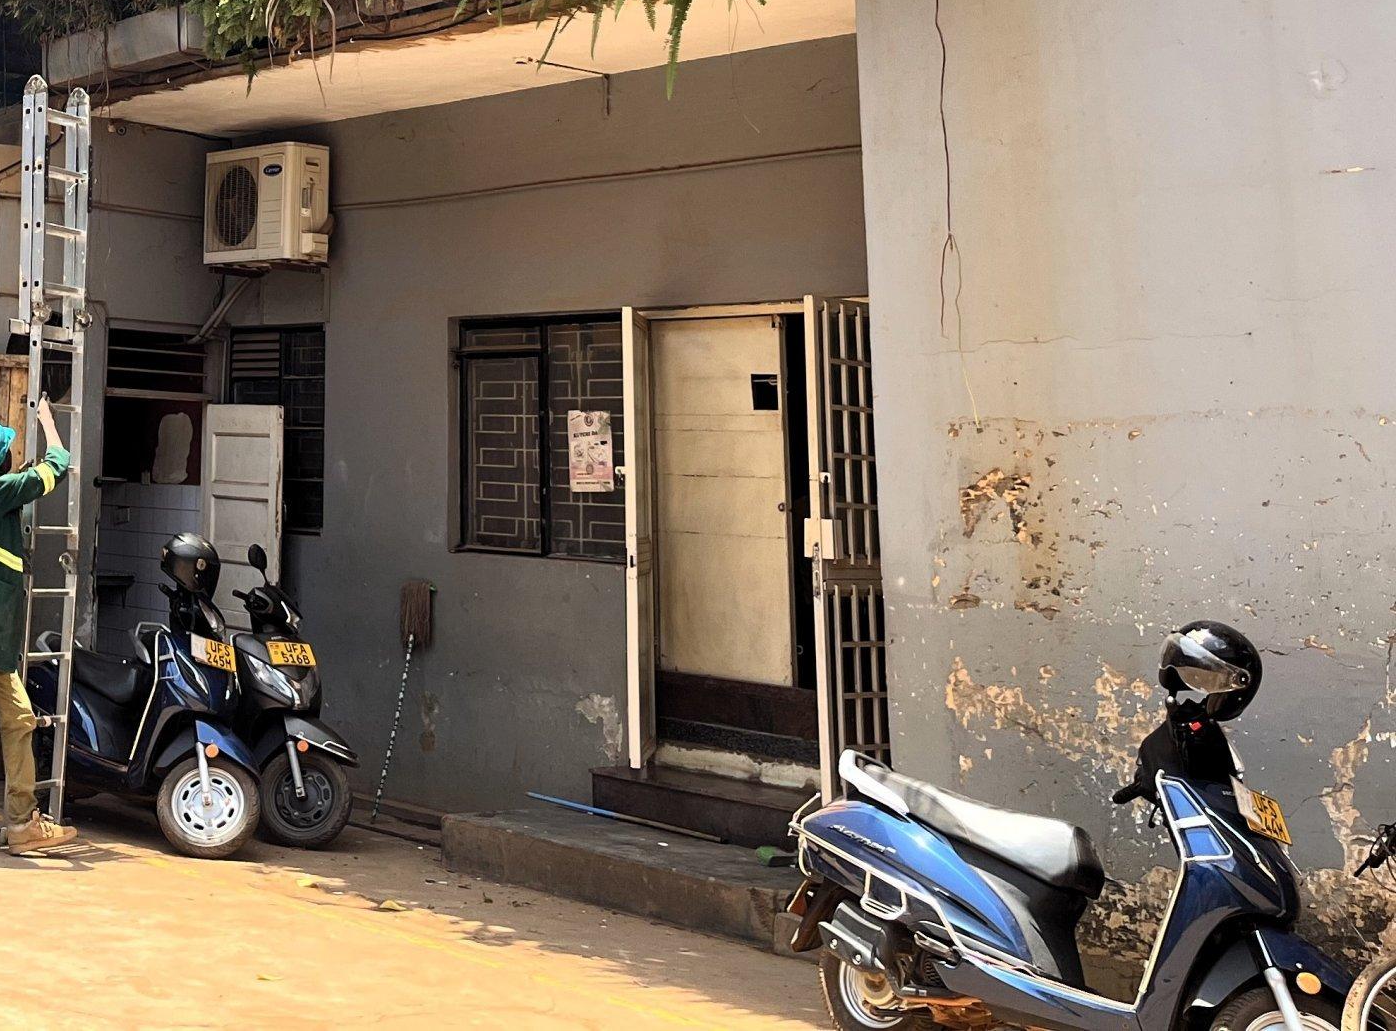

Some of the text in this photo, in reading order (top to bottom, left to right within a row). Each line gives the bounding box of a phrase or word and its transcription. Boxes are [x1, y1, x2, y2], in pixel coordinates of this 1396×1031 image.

[210, 641, 230, 656] UFS
[284, 643, 307, 654] UFA
[281, 651, 311, 665] 516B
[1252, 792, 1278, 819] UFS
